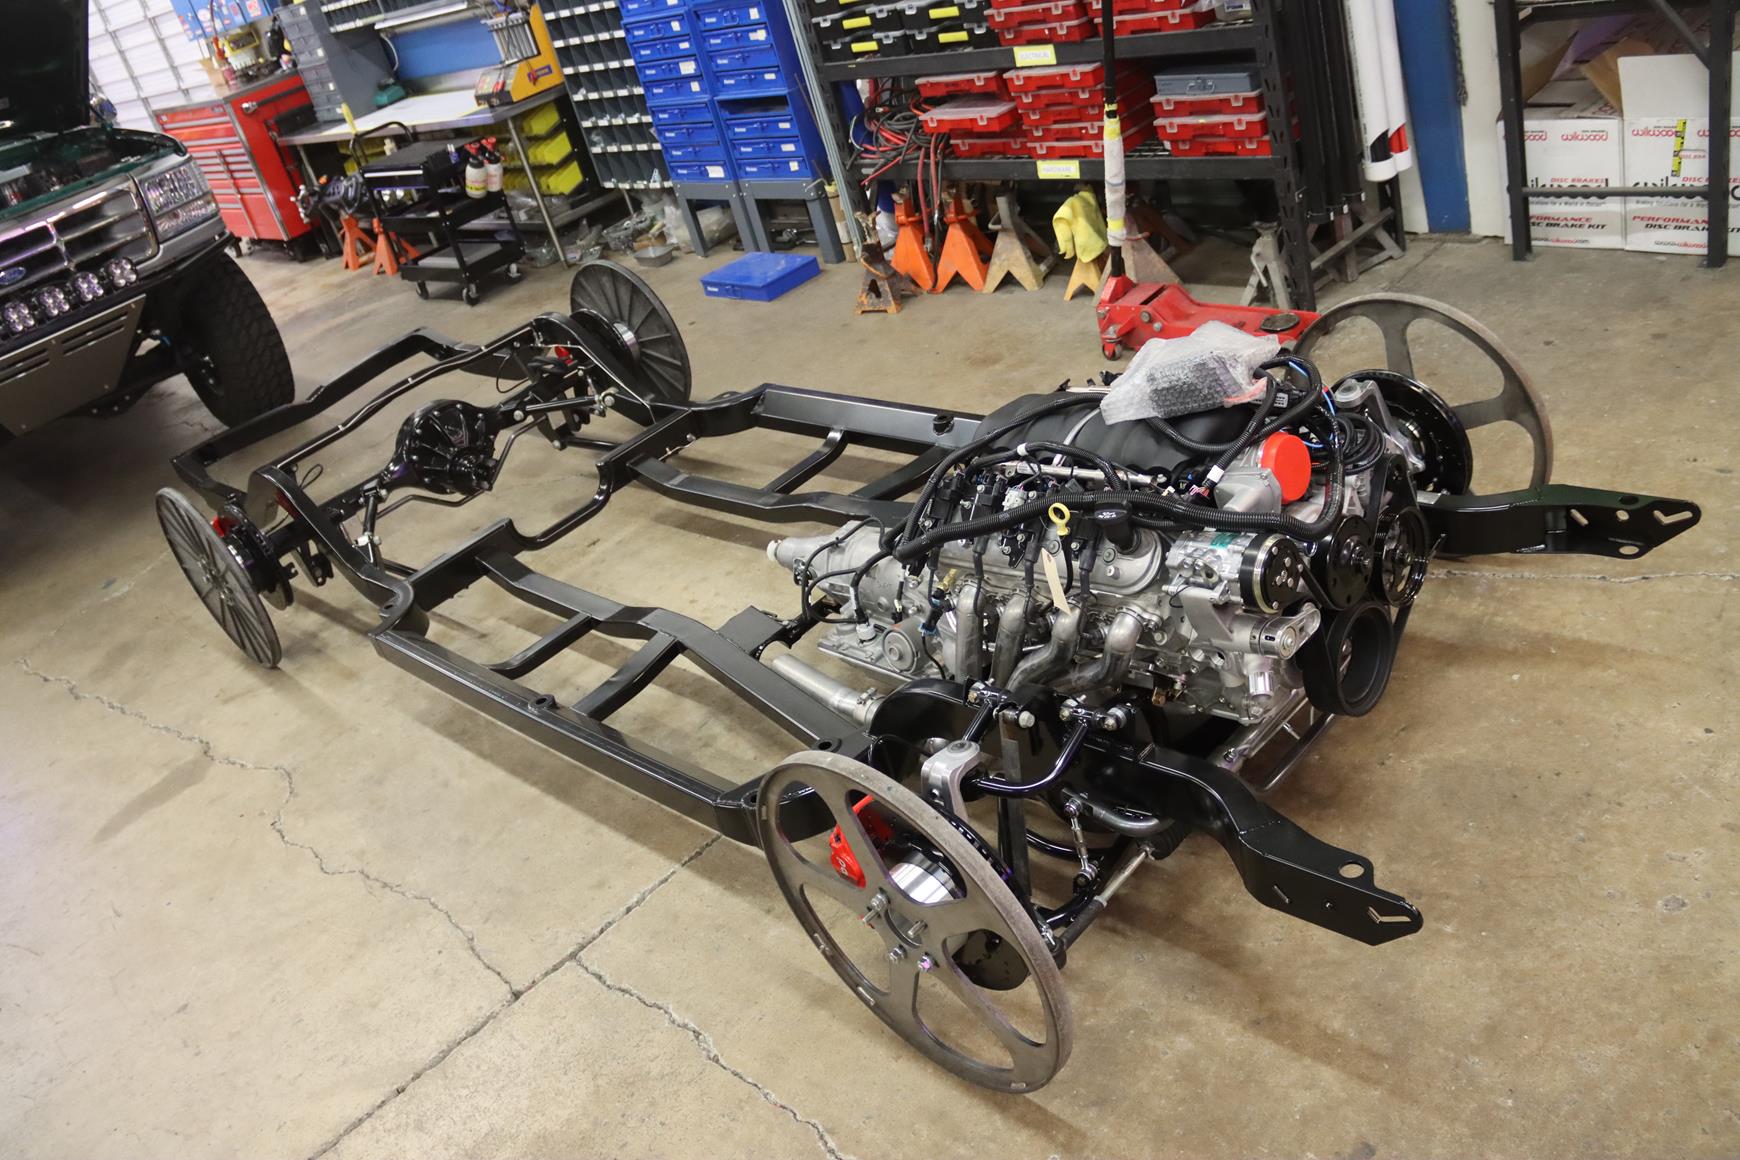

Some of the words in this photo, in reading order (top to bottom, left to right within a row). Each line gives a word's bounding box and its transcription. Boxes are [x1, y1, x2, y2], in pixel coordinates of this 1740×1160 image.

[1561, 127, 1608, 141] wilwood
[1632, 127, 1676, 138] wilwoo
[1530, 215, 1592, 223] FORMANCE
[1632, 215, 1709, 225] PERFORMAN
